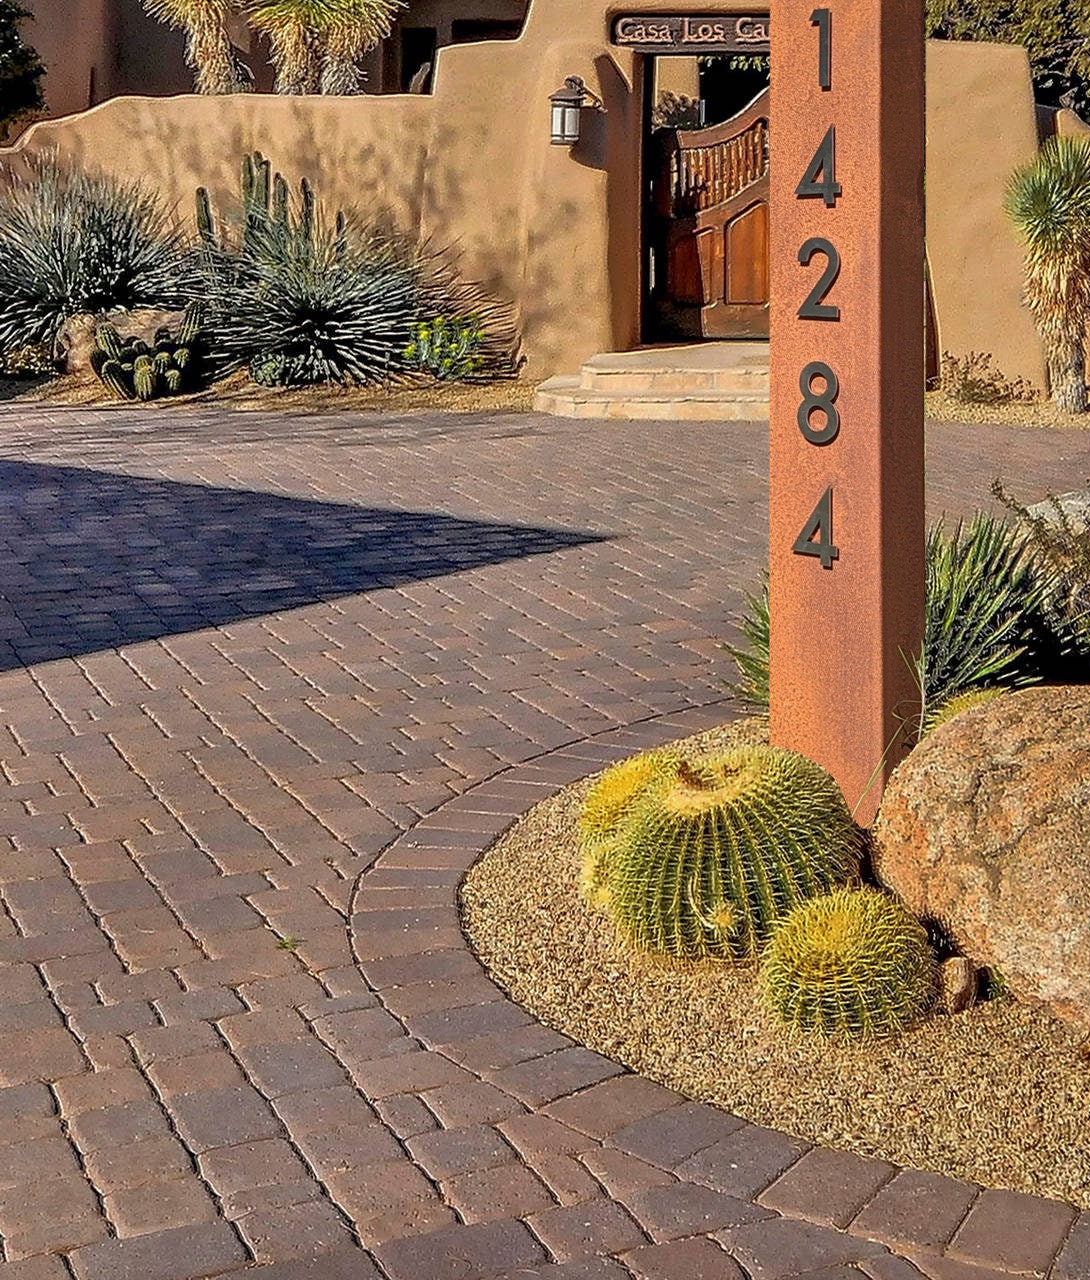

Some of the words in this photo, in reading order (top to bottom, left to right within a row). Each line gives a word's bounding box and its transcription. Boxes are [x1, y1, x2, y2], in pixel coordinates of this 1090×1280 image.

[616, 18, 672, 41] Casa
[682, 17, 725, 41] Los
[735, 16, 770, 41] Ca
[793, 8, 842, 568] 14284
